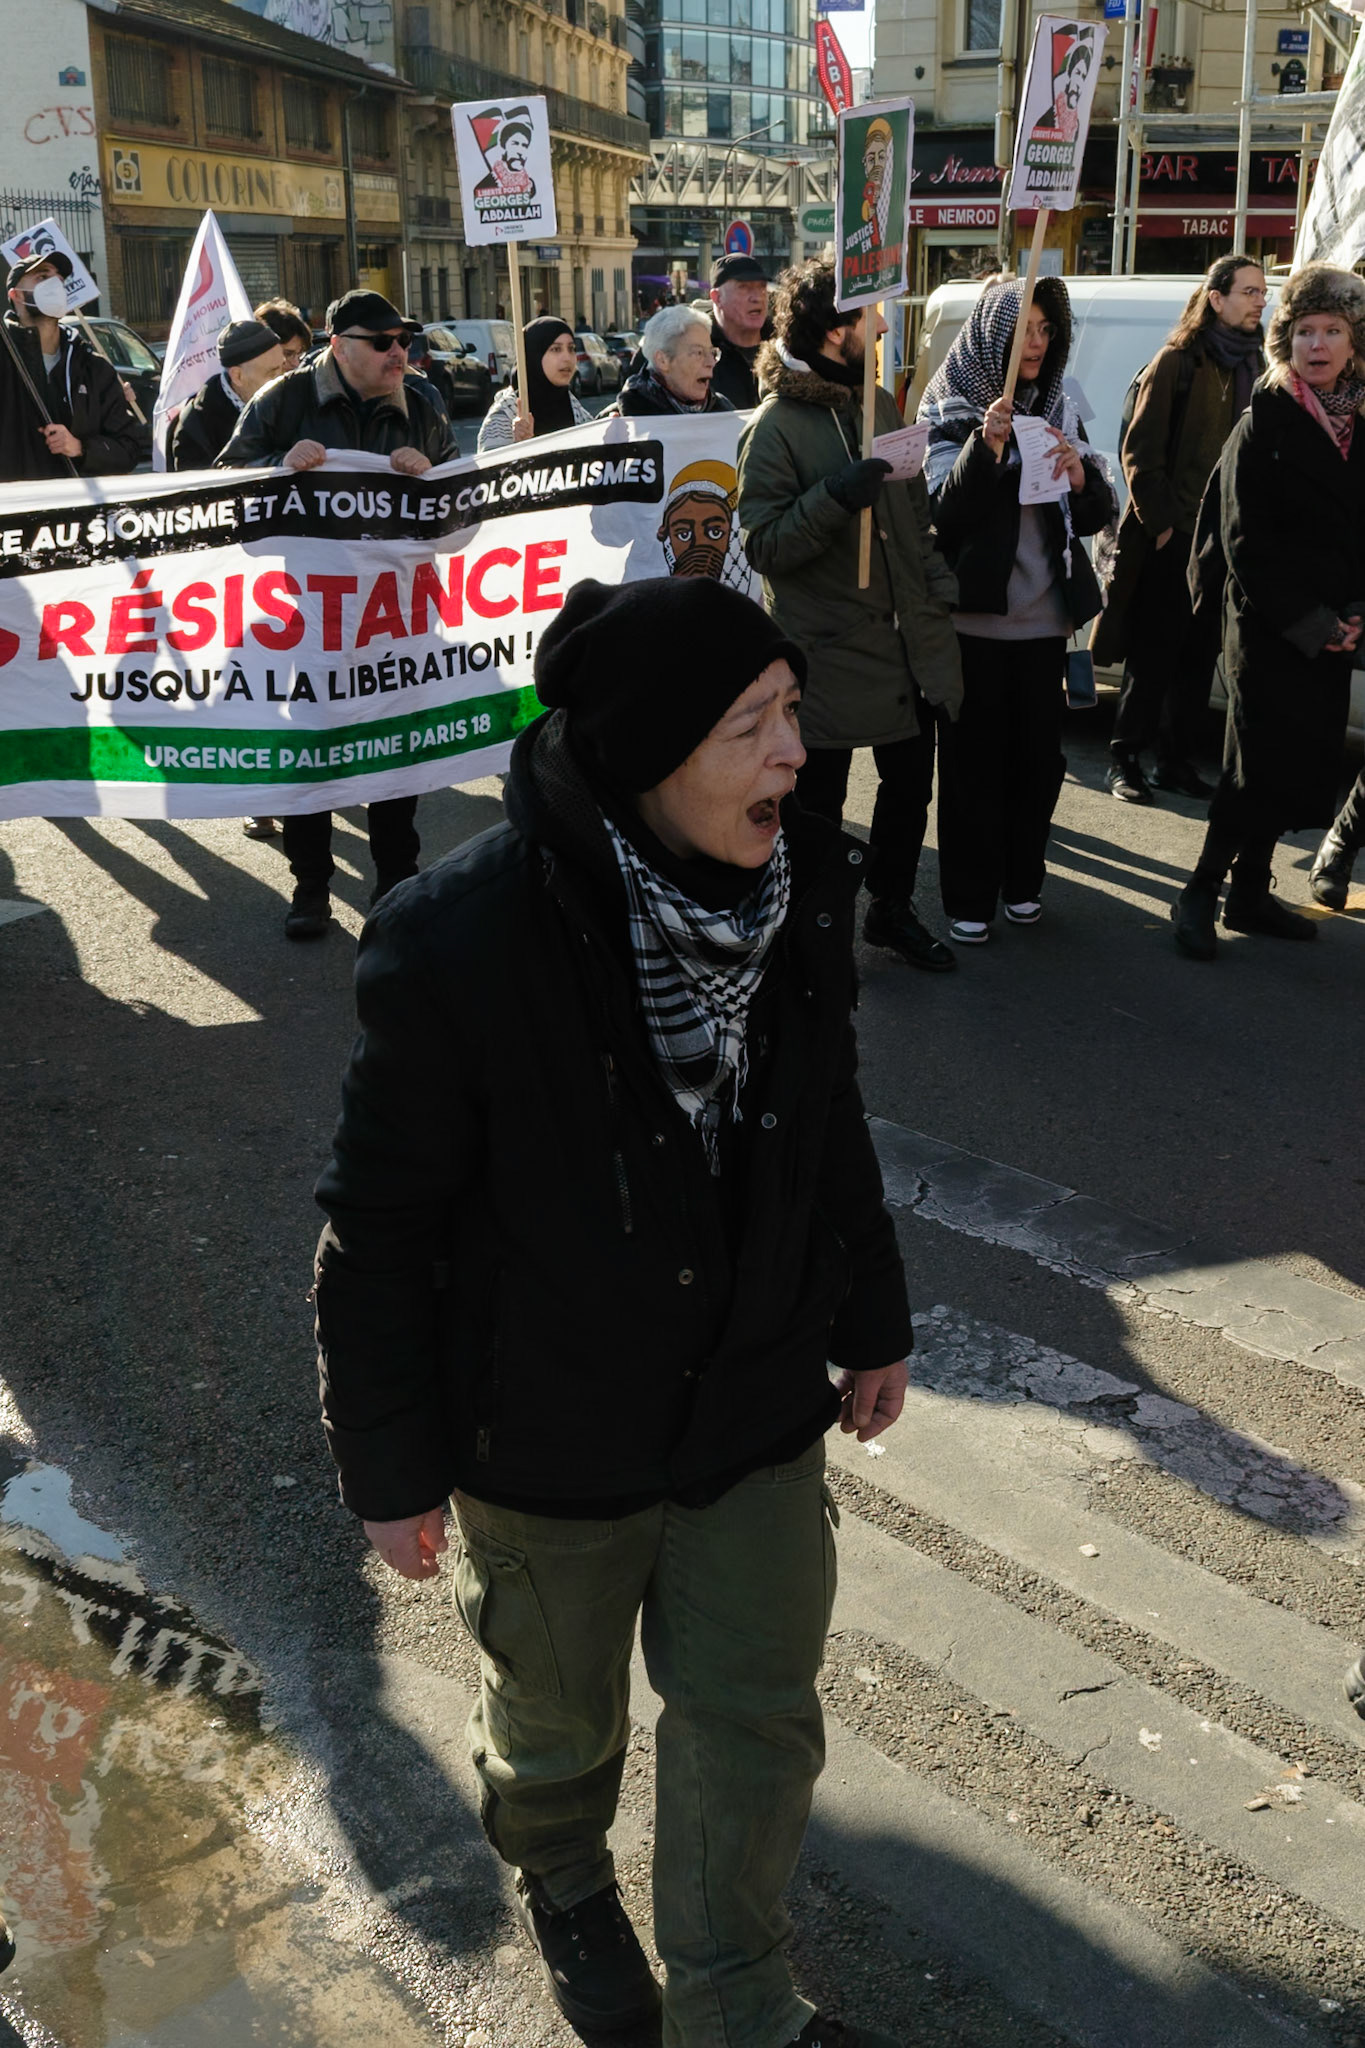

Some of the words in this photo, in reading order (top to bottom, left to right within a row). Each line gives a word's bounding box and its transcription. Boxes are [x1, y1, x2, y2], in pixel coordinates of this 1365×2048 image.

[1027, 143, 1074, 165] GEORGES
[1028, 170, 1075, 187] ABDALLAH
[1139, 154, 1200, 182] BAR
[474, 193, 530, 208] GEORGES
[481, 206, 541, 221] ABDALLAH
[938, 208, 997, 225] NEMROD
[845, 221, 874, 250] JUSTICE
[1182, 218, 1229, 235] TABAC
[861, 237, 872, 253] EN
[31, 522, 80, 551] AU
[86, 500, 236, 545] SIONISME
[243, 495, 278, 523] ET
[282, 484, 306, 515] À
[313, 489, 392, 519] TOUS
[400, 493, 451, 521] LES
[455, 457, 657, 512] COLONIALISMES
[38, 538, 568, 661] RÉSISTANCE
[70, 660, 254, 702] JUSQU'À
[265, 669, 318, 703] LA
[328, 635, 515, 701] LIBÉRATION
[144, 745, 272, 769] URGENCE
[279, 734, 403, 769] PALESTINE
[409, 719, 468, 752] PARIS
[471, 713, 491, 734] 18
